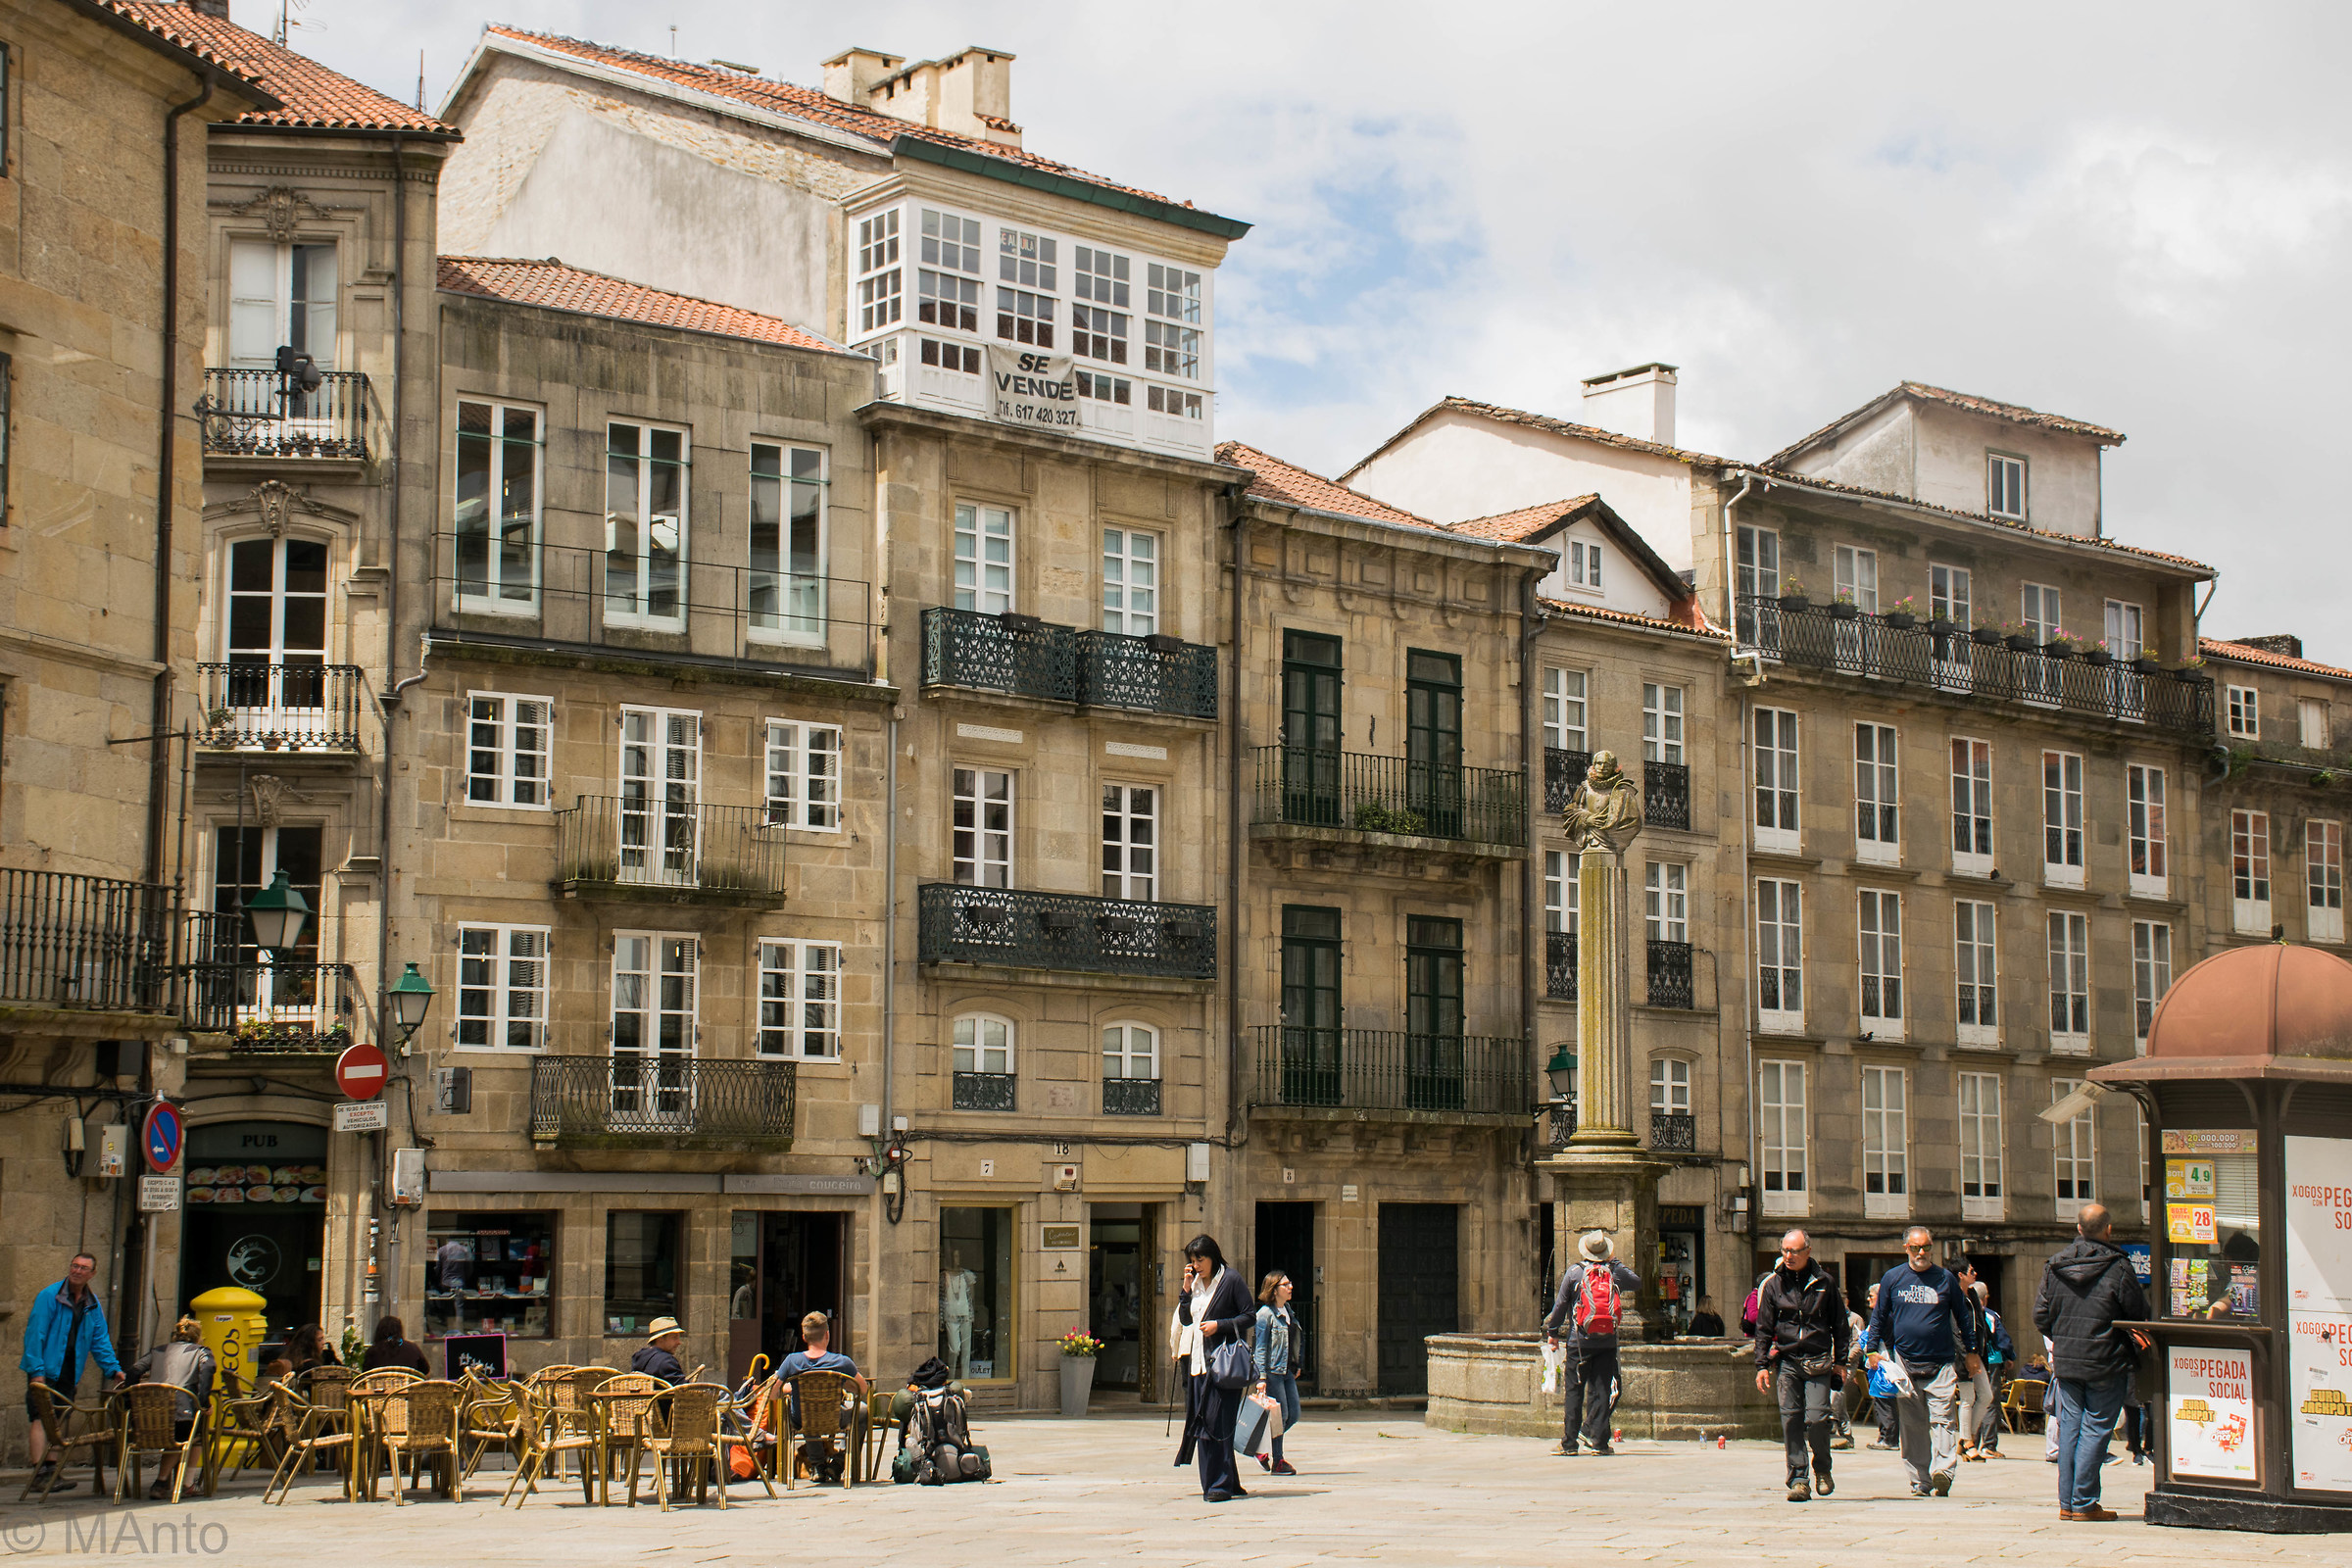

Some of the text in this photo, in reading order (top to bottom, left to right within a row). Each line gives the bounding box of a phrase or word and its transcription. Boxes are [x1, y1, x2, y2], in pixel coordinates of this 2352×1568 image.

[1017, 353, 1051, 374] SE
[995, 371, 1074, 401] VENDE
[1015, 404, 1034, 419] 617
[1037, 408, 1053, 423] 420
[1056, 410, 1076, 425] 327
[242, 1135, 278, 1148] PUB
[1056, 1144, 1069, 1154] 18
[985, 1164, 990, 1173] 7
[1287, 1172, 1292, 1181] 8
[809, 1179, 861, 1190] couceiro
[2292, 1185, 2323, 1199] XOGOS
[2194, 1211, 2211, 1227] 28
[2174, 1357, 2246, 1380] XOGOS PEGADA
[2209, 1382, 2247, 1404] SOCIAL
[2311, 1390, 2343, 1403] EURO
[2183, 1399, 2207, 1411] EURO
[2300, 1400, 2352, 1416] JACKPOT
[2176, 1409, 2215, 1422] JACKPOT
